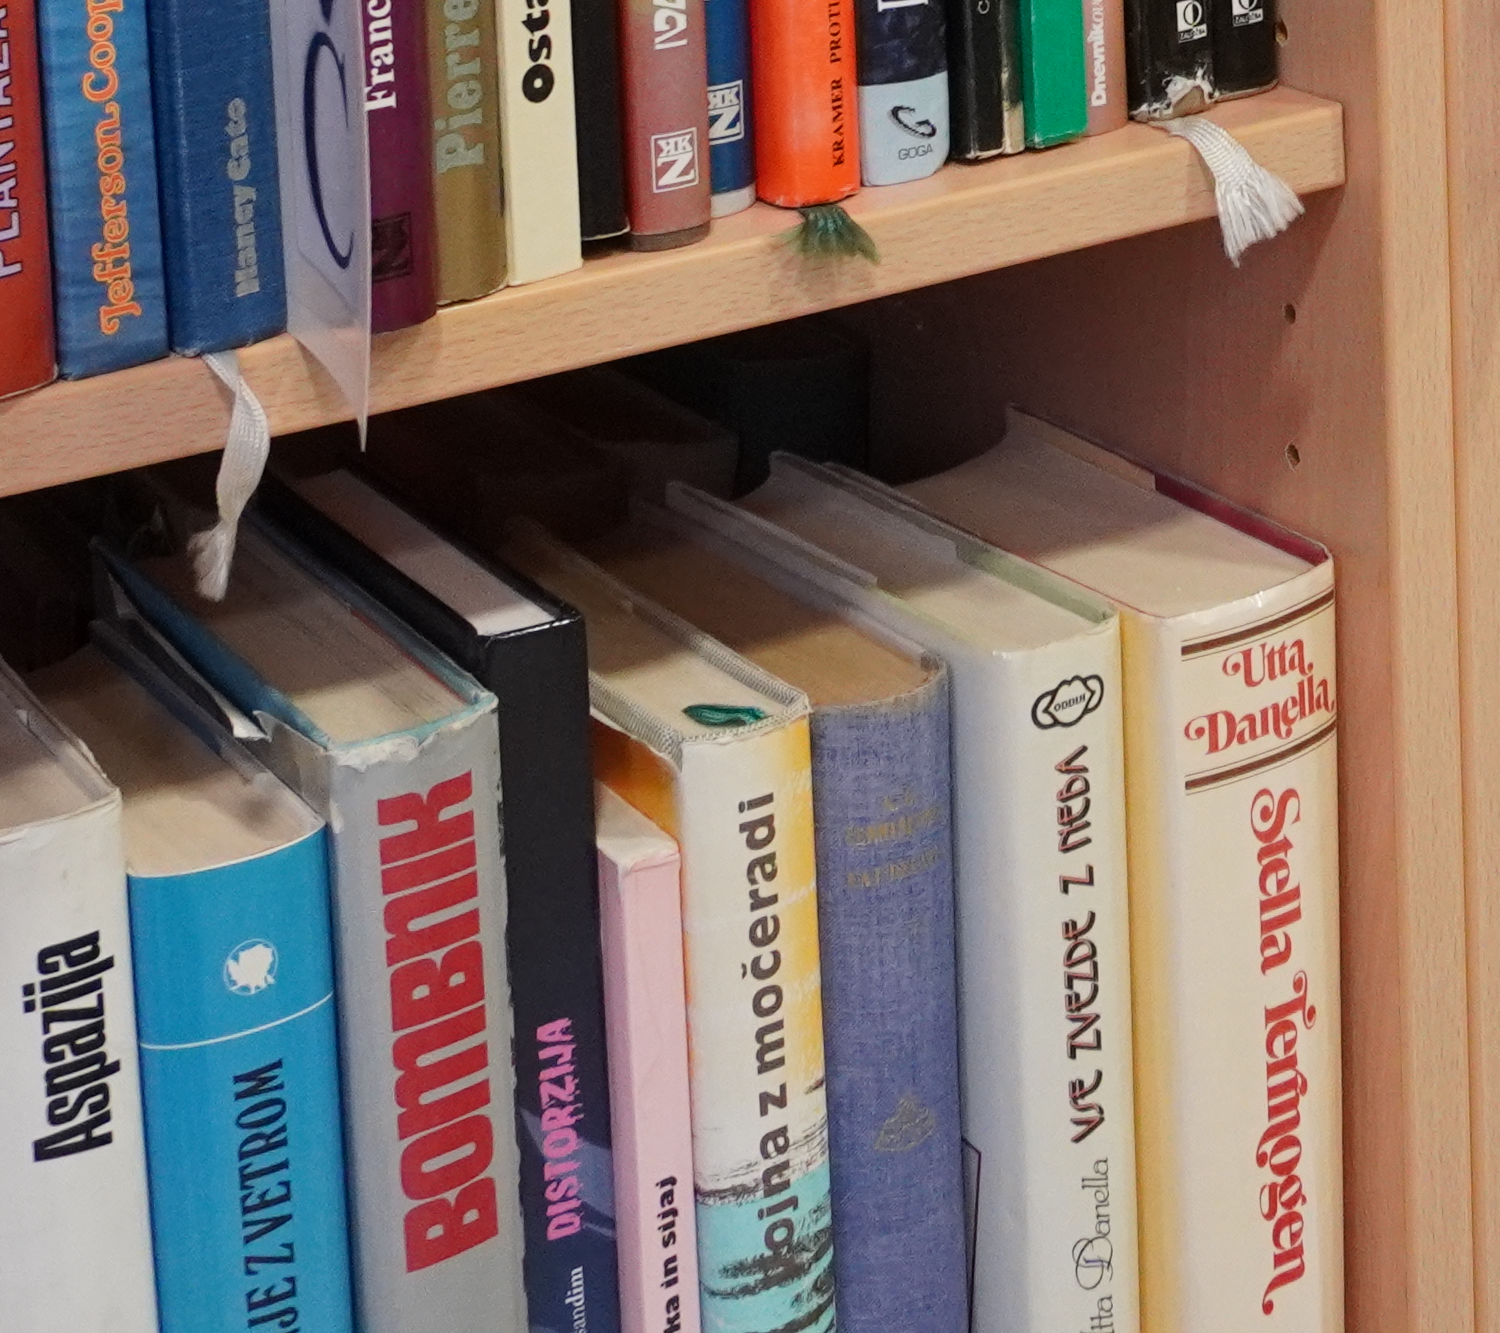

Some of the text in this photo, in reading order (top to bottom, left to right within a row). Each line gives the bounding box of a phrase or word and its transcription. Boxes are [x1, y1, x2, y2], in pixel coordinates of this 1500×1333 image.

[95, 103, 142, 335] Jefferson
[827, 72, 848, 168] KRAMER
[739, 792, 784, 1073] močeradi
[1251, 788, 1300, 974] Stella
[24, 931, 120, 1161] Aspazija
[375, 772, 499, 1271] BOMBNIK
[537, 1019, 586, 1239] DISTORZIJA
[231, 1059, 292, 1237] VETROM
